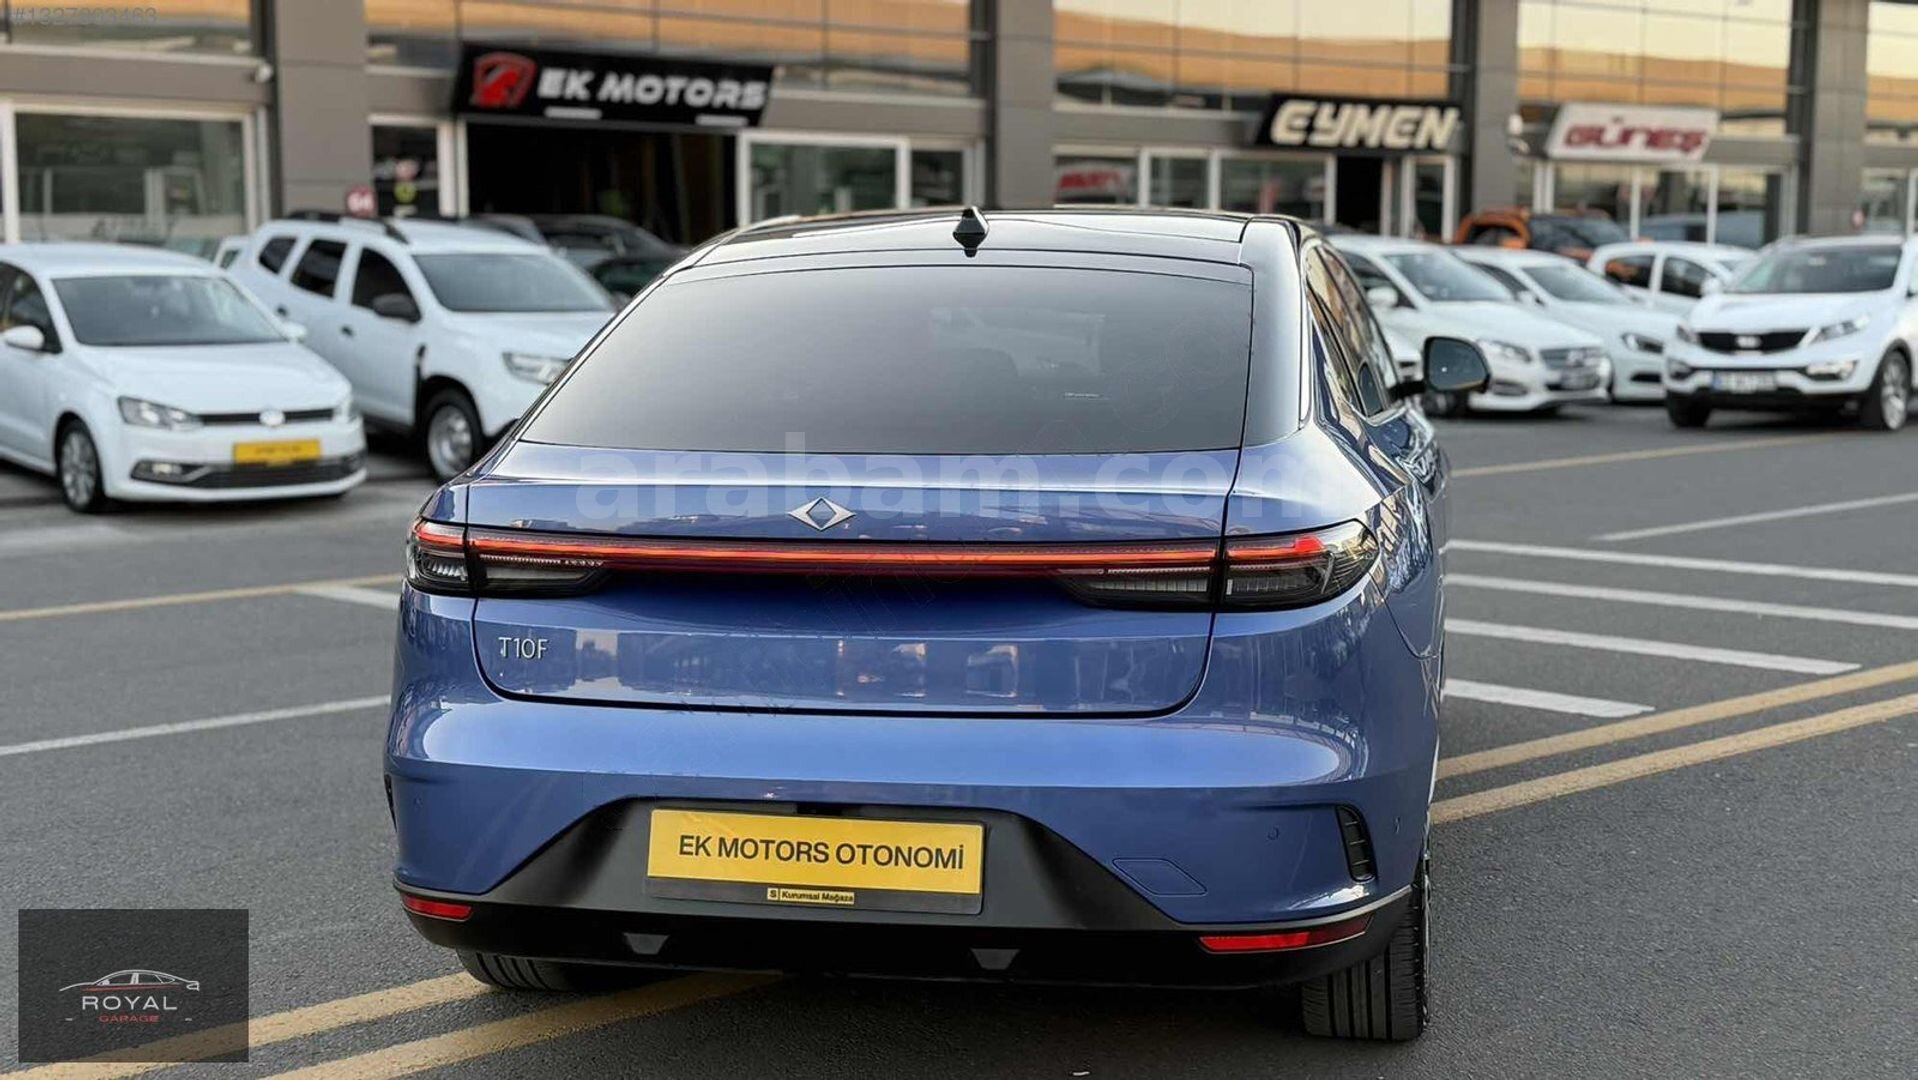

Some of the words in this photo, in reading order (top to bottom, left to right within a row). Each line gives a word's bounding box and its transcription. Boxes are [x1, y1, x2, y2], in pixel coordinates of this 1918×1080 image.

[538, 68, 594, 99] EK
[598, 72, 767, 110] MOTORS
[1271, 100, 1460, 149] EYMEN
[498, 636, 548, 660] T10F
[679, 834, 711, 857] EK
[717, 837, 829, 863] MOTORS
[835, 843, 964, 870] OTONOMİ
[781, 890, 819, 900] Kurumsal
[821, 892, 853, 903] Mağaza
